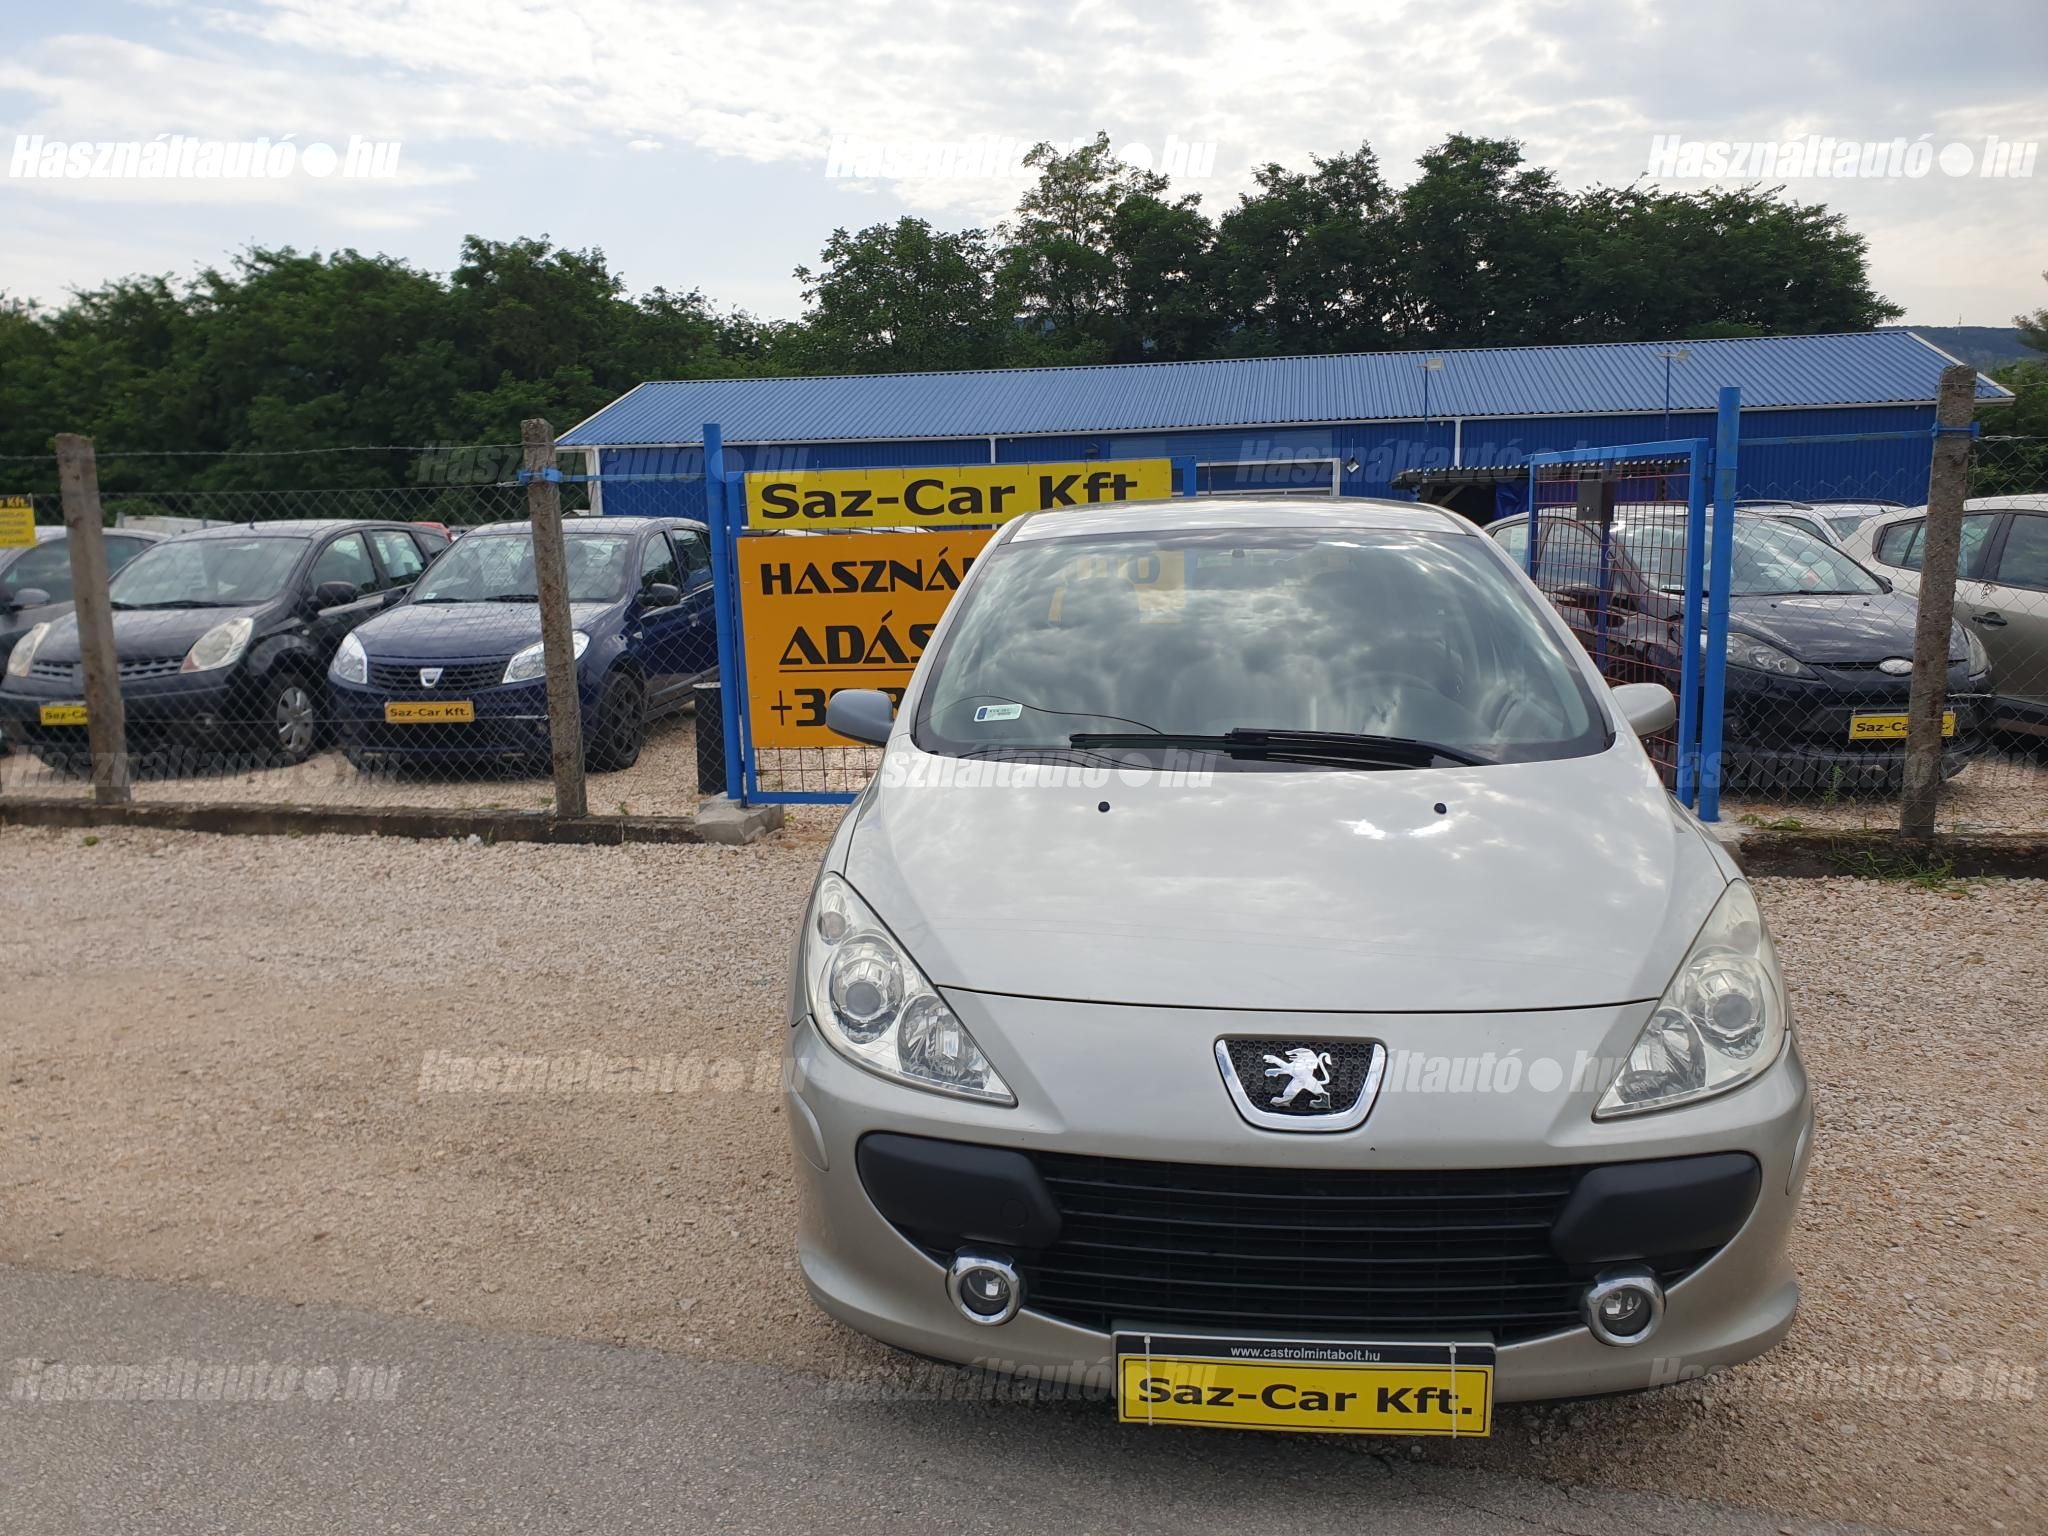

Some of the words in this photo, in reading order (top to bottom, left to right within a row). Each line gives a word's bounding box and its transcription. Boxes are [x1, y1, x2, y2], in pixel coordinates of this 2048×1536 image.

[761, 478, 1015, 519] Saz-Car
[45, 709, 88, 720] Saz-Ca
[390, 708, 441, 717] Saz-Car
[445, 707, 470, 716] Kft.
[770, 688, 862, 727] +3
[1855, 721, 1909, 732] Saz-Ca
[1230, 1346, 1381, 1362] www.castrolmintabolt.hu
[1137, 1377, 1357, 1412] Saz-Car
[1375, 1386, 1473, 1415] Kft.
